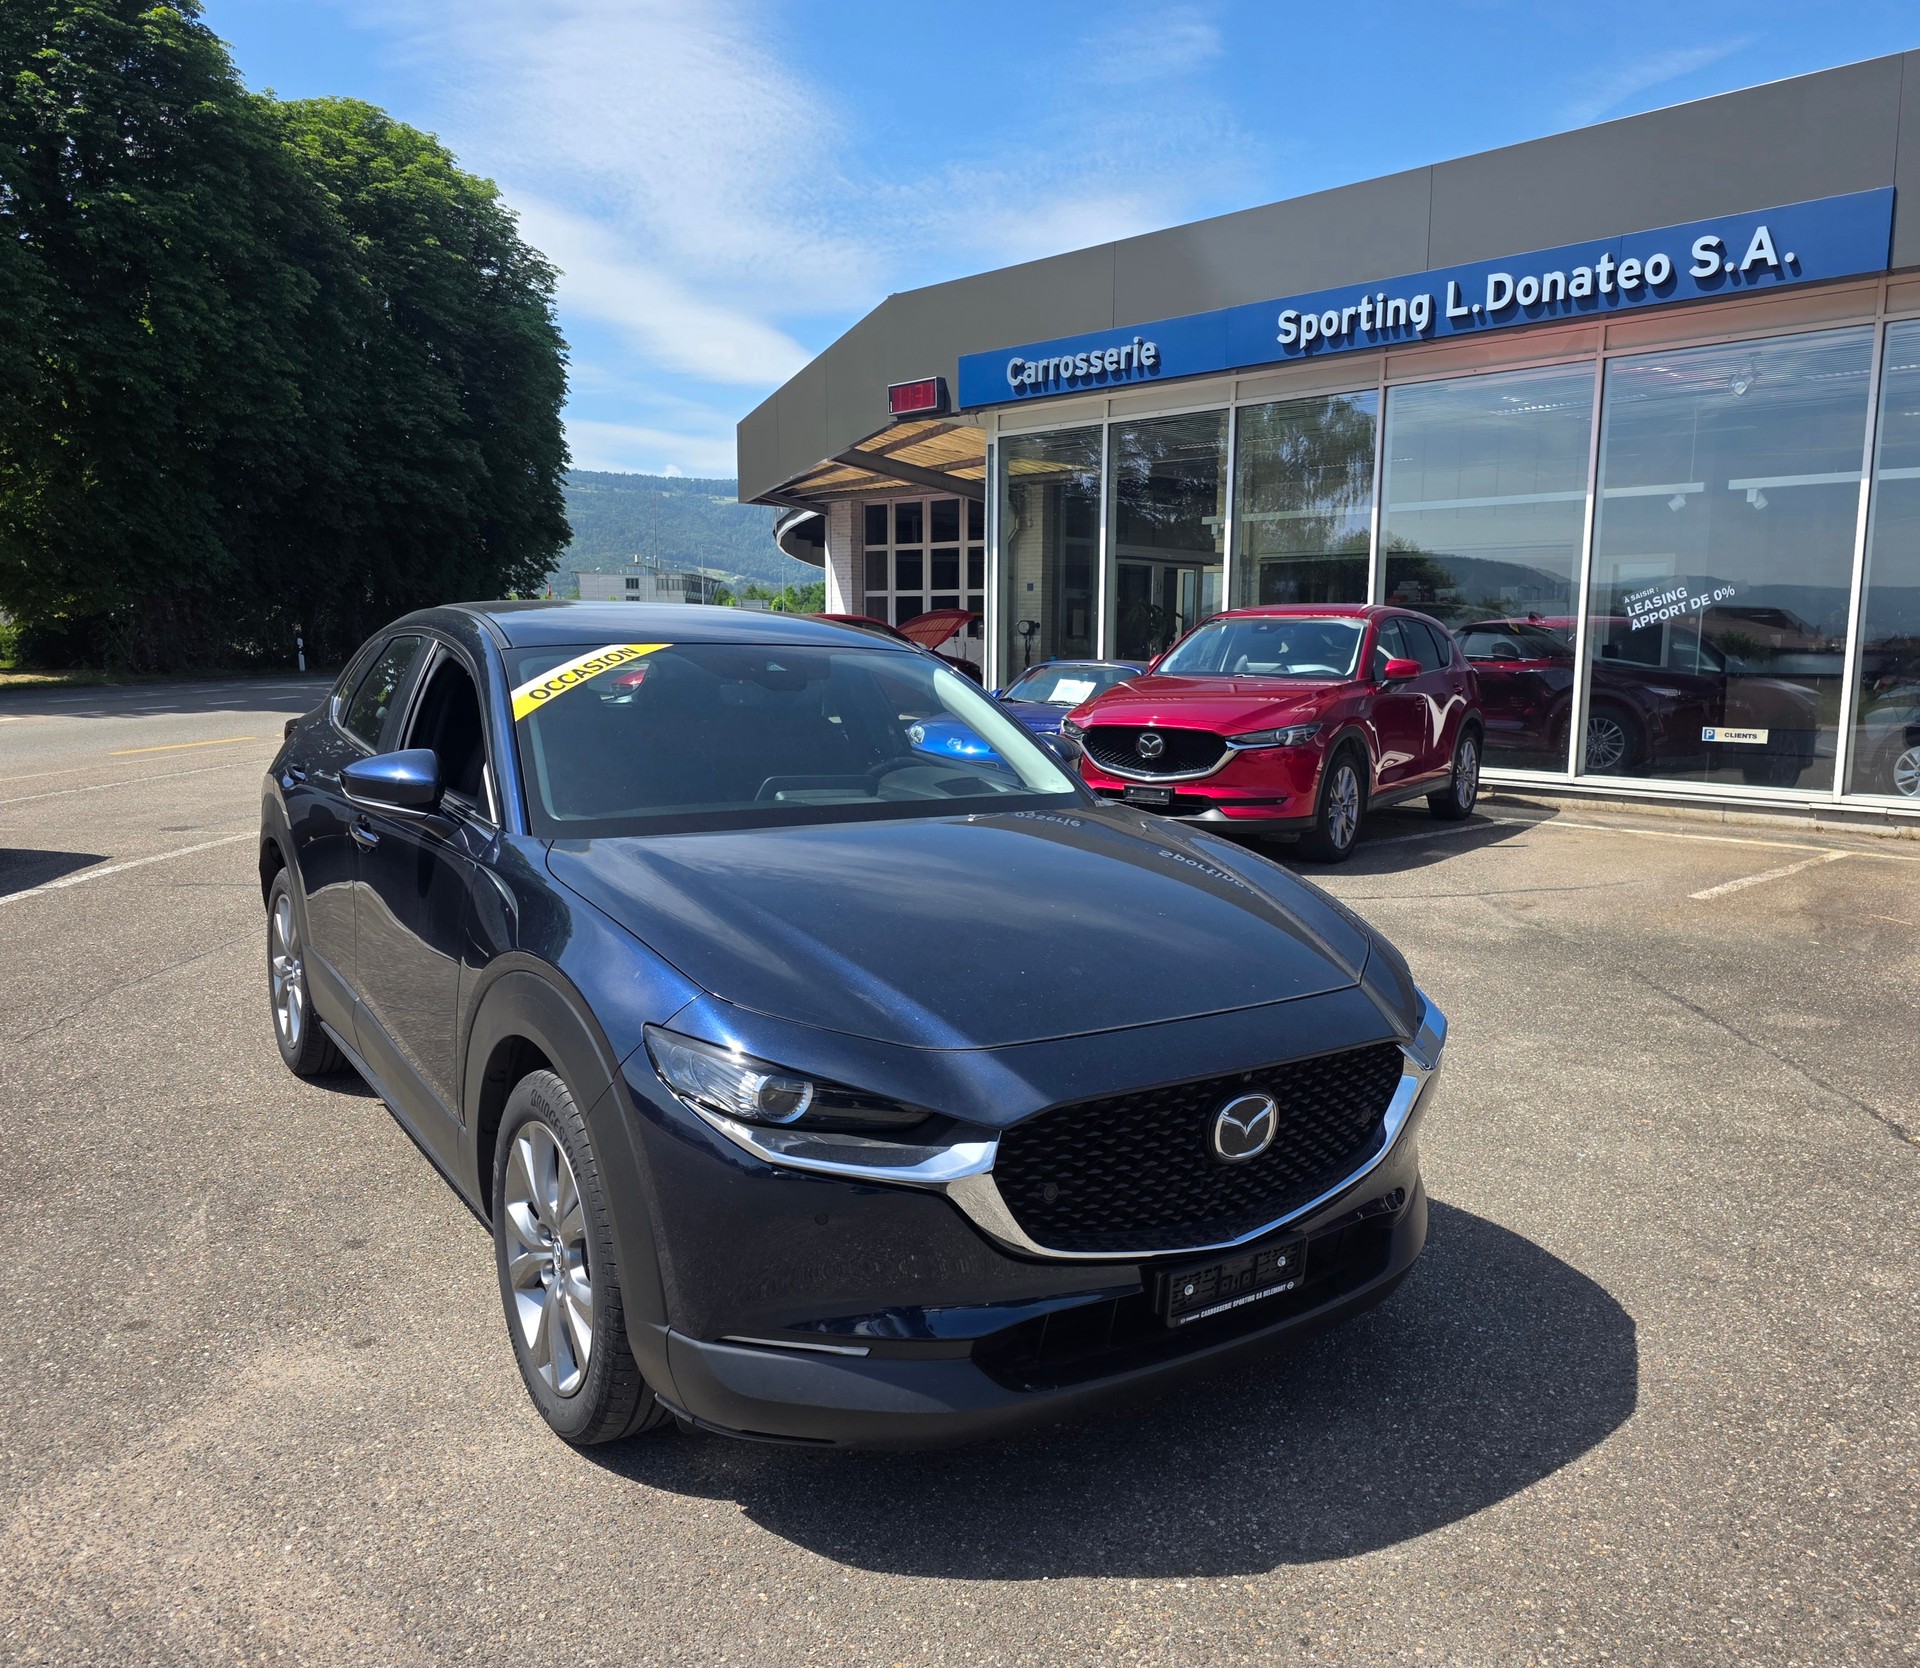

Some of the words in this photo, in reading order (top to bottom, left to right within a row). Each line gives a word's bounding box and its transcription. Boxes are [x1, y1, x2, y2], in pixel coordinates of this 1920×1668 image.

[1007, 336, 1157, 386] Carrosserie
[1276, 292, 1431, 349] Sporting
[1446, 251, 1671, 318] L.Donateo
[1688, 225, 1796, 278] S.A.
[1626, 586, 1688, 617] LEASING
[1631, 601, 1687, 631] APPORT
[1689, 593, 1711, 610] DE
[1713, 585, 1736, 601] 0%
[528, 647, 640, 700] OCCASION
[1724, 732, 1758, 740] CLIENTS
[530, 1088, 583, 1183] BRIDGESTONE
